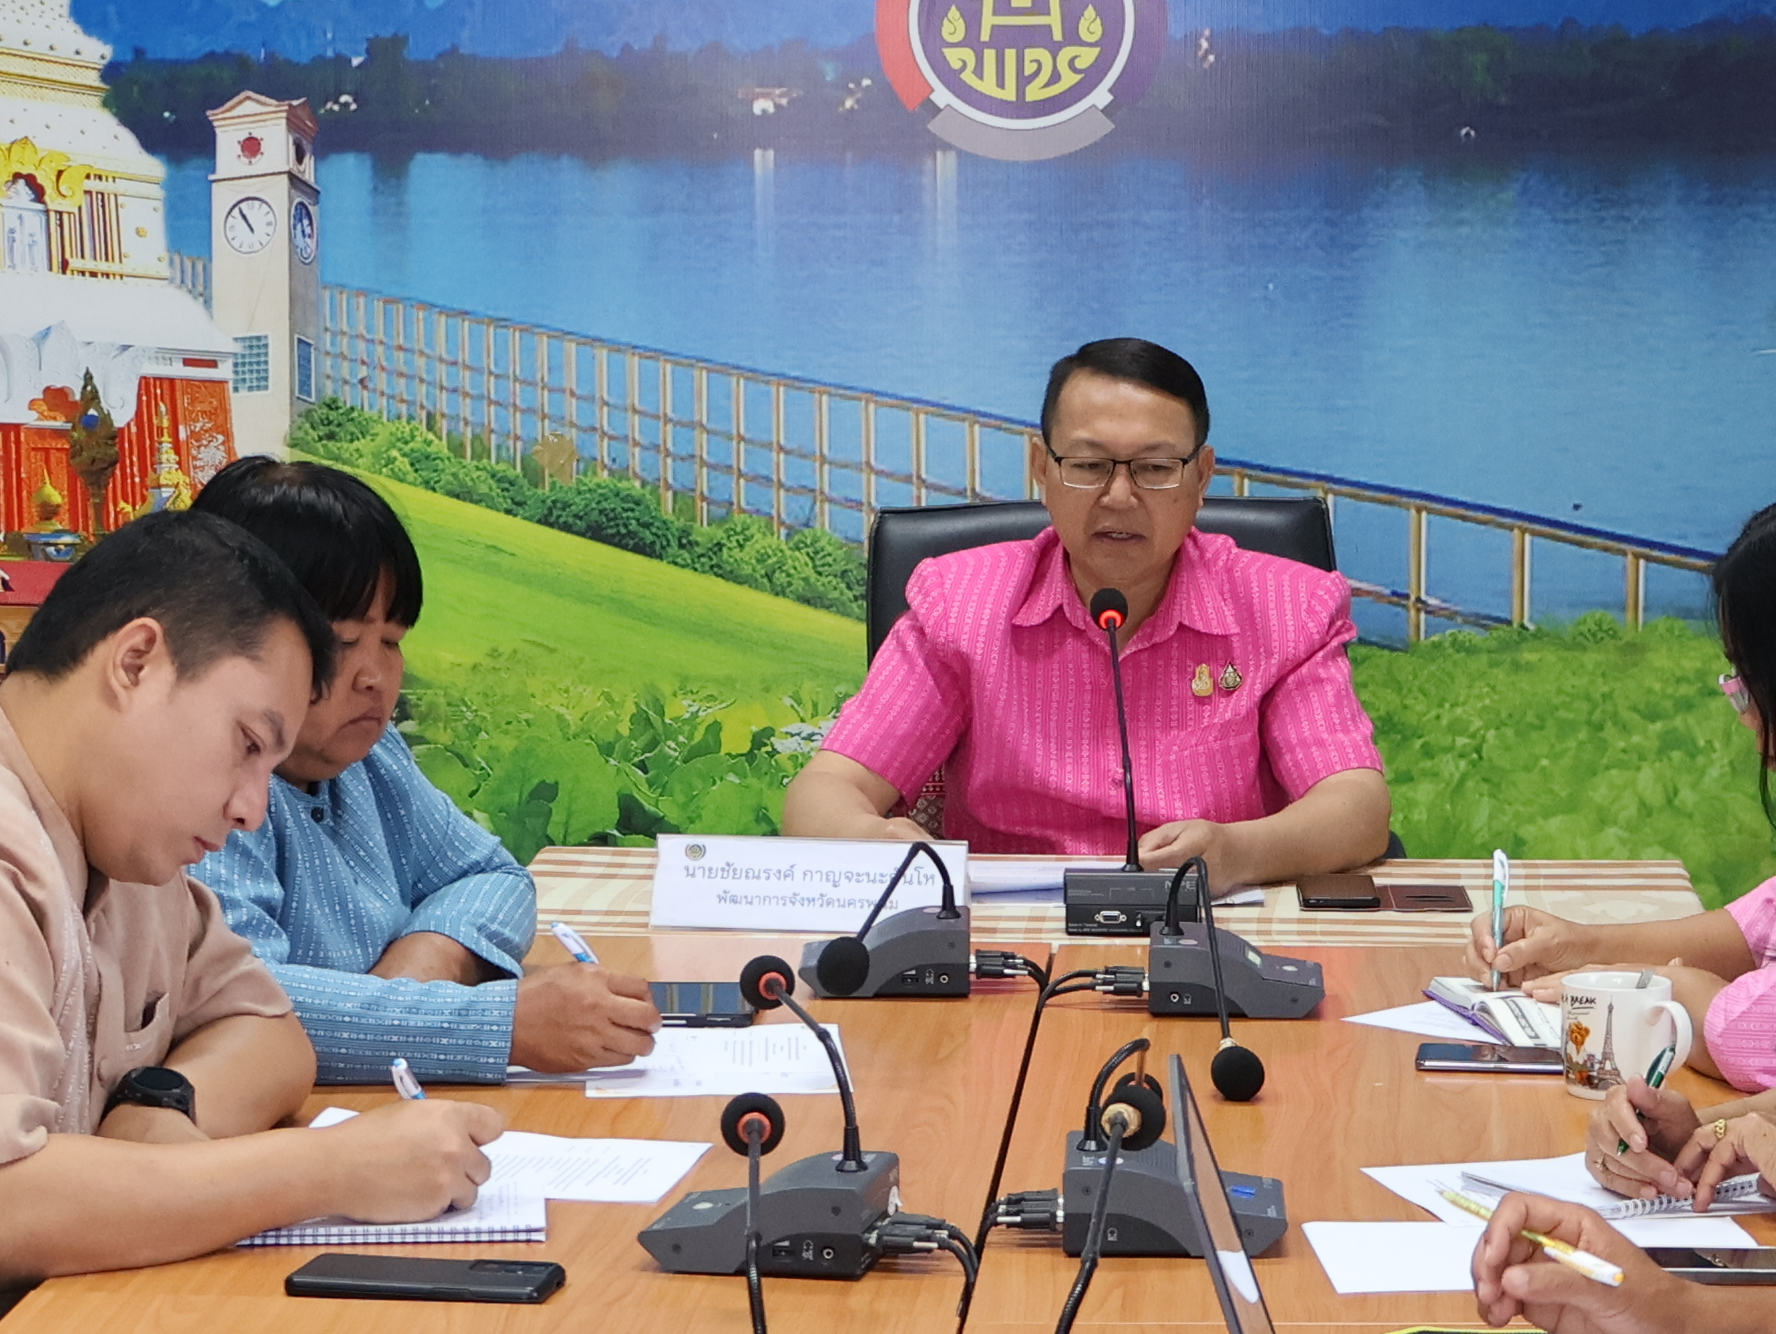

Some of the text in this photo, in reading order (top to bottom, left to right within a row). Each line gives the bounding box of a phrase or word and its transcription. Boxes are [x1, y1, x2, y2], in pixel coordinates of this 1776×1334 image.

[683, 862, 937, 889] นายชัยณรงค์ กาญจะนะนโห
[716, 889, 899, 910] พัฒนาการจังหวัดนครพม
